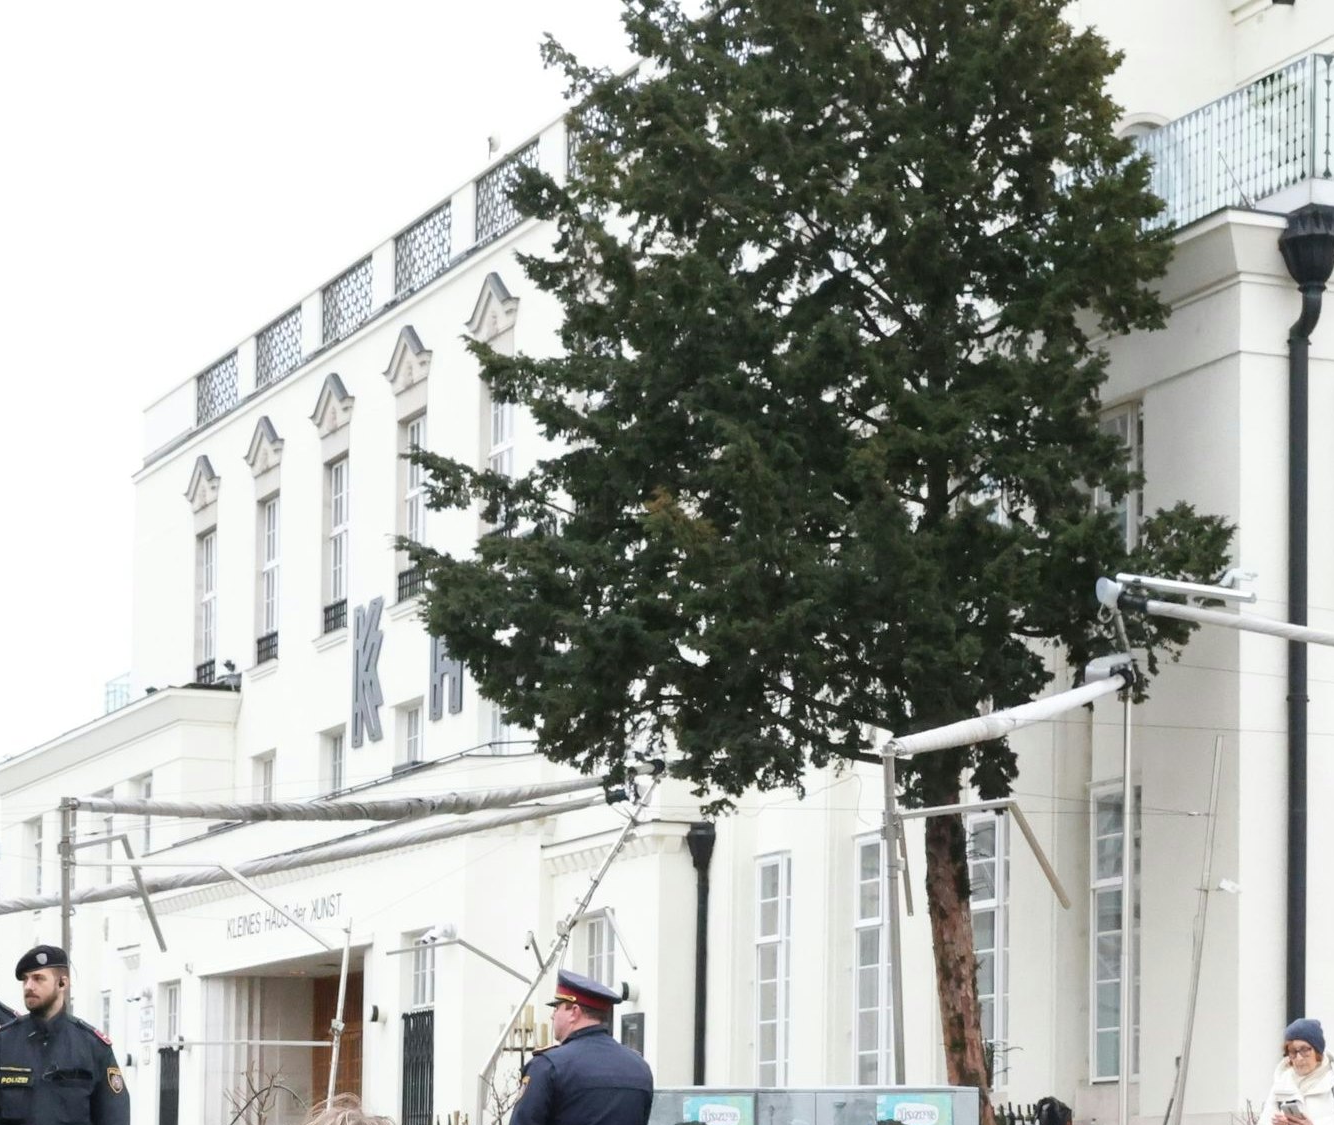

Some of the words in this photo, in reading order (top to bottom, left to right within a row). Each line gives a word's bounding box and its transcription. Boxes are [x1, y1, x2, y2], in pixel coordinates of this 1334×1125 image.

[226, 911, 261, 940] KLEINES
[265, 904, 289, 932] HAUS
[310, 892, 342, 922] KUNST
[0, 1076, 29, 1085] POLIZEI
